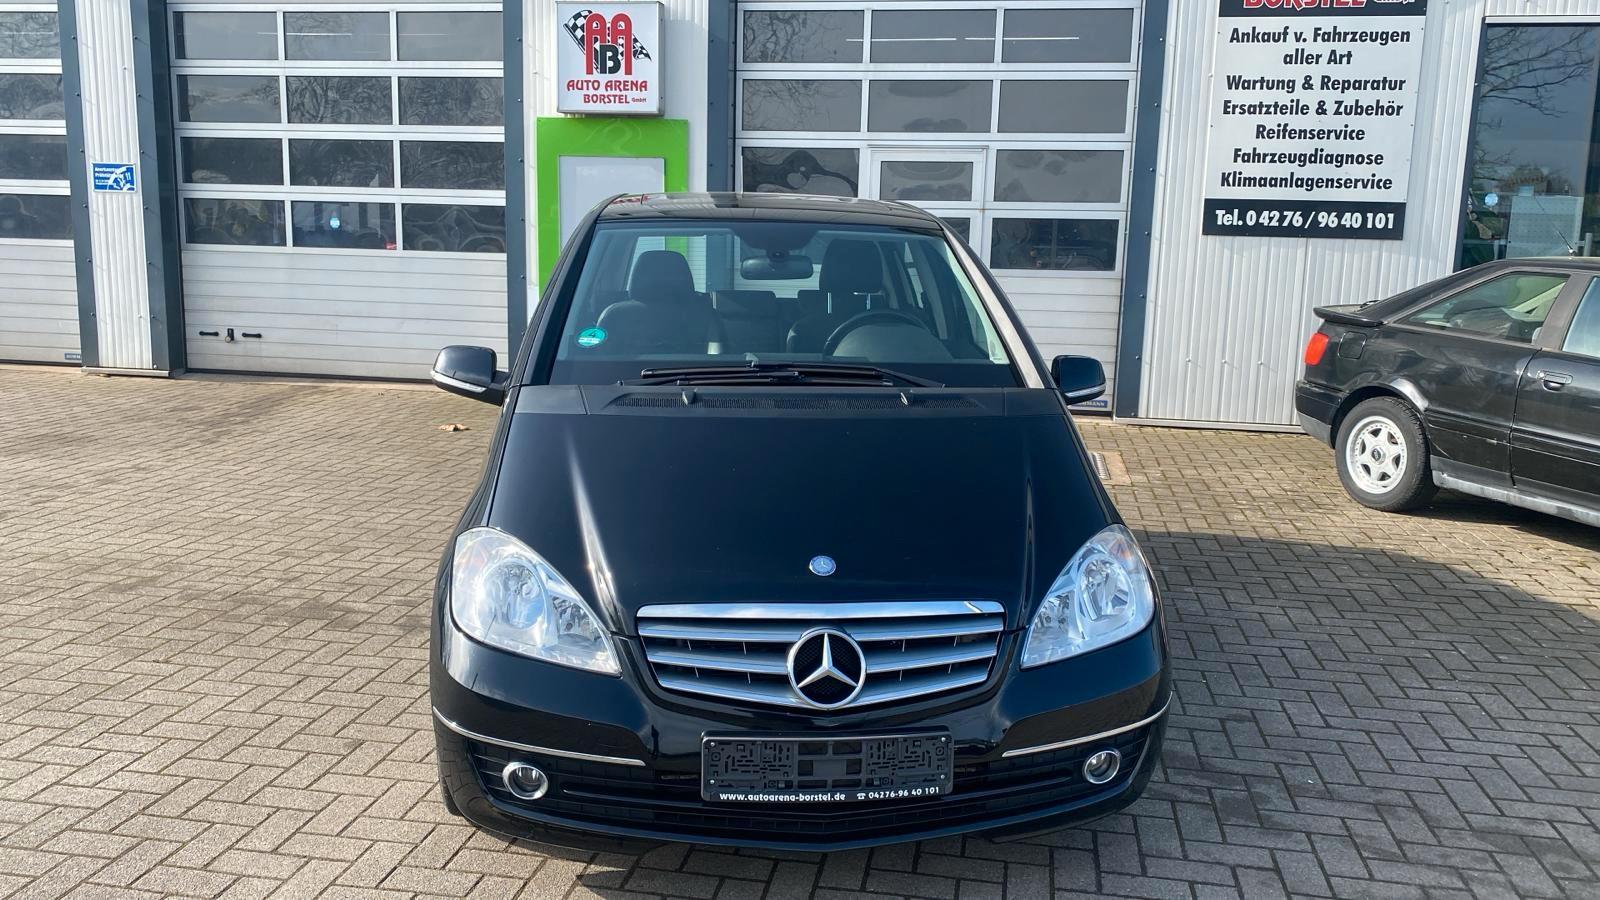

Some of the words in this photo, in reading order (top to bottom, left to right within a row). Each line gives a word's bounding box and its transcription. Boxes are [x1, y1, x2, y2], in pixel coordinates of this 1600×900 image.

[1229, 25, 1289, 44] Ankauf
[1293, 31, 1308, 43] v.
[1312, 25, 1411, 46] Fahrzeugen
[1282, 47, 1323, 65] aller
[1326, 49, 1353, 65] Art
[566, 79, 601, 91] AUTO
[604, 80, 648, 92] ARENA
[1226, 74, 1296, 93] Wartung
[1301, 74, 1315, 91] &
[1319, 75, 1407, 93] Reparatur
[583, 94, 630, 104] BORSTEL
[1222, 98, 1310, 116] Ersatzteile
[1315, 99, 1328, 116] &
[1332, 98, 1404, 116] Zubehör
[1255, 122, 1366, 141] Reifenservice
[1233, 147, 1384, 168] Fahrzeugdiagnose
[1220, 170, 1393, 192] Klimaanlagenservice
[1215, 208, 1243, 226] Tel.
[719, 792, 846, 801] www.autoarena-borstel.de
[868, 790, 910, 799] 04276-96
[911, 788, 923, 797] 40
[925, 786, 940, 795] 101
